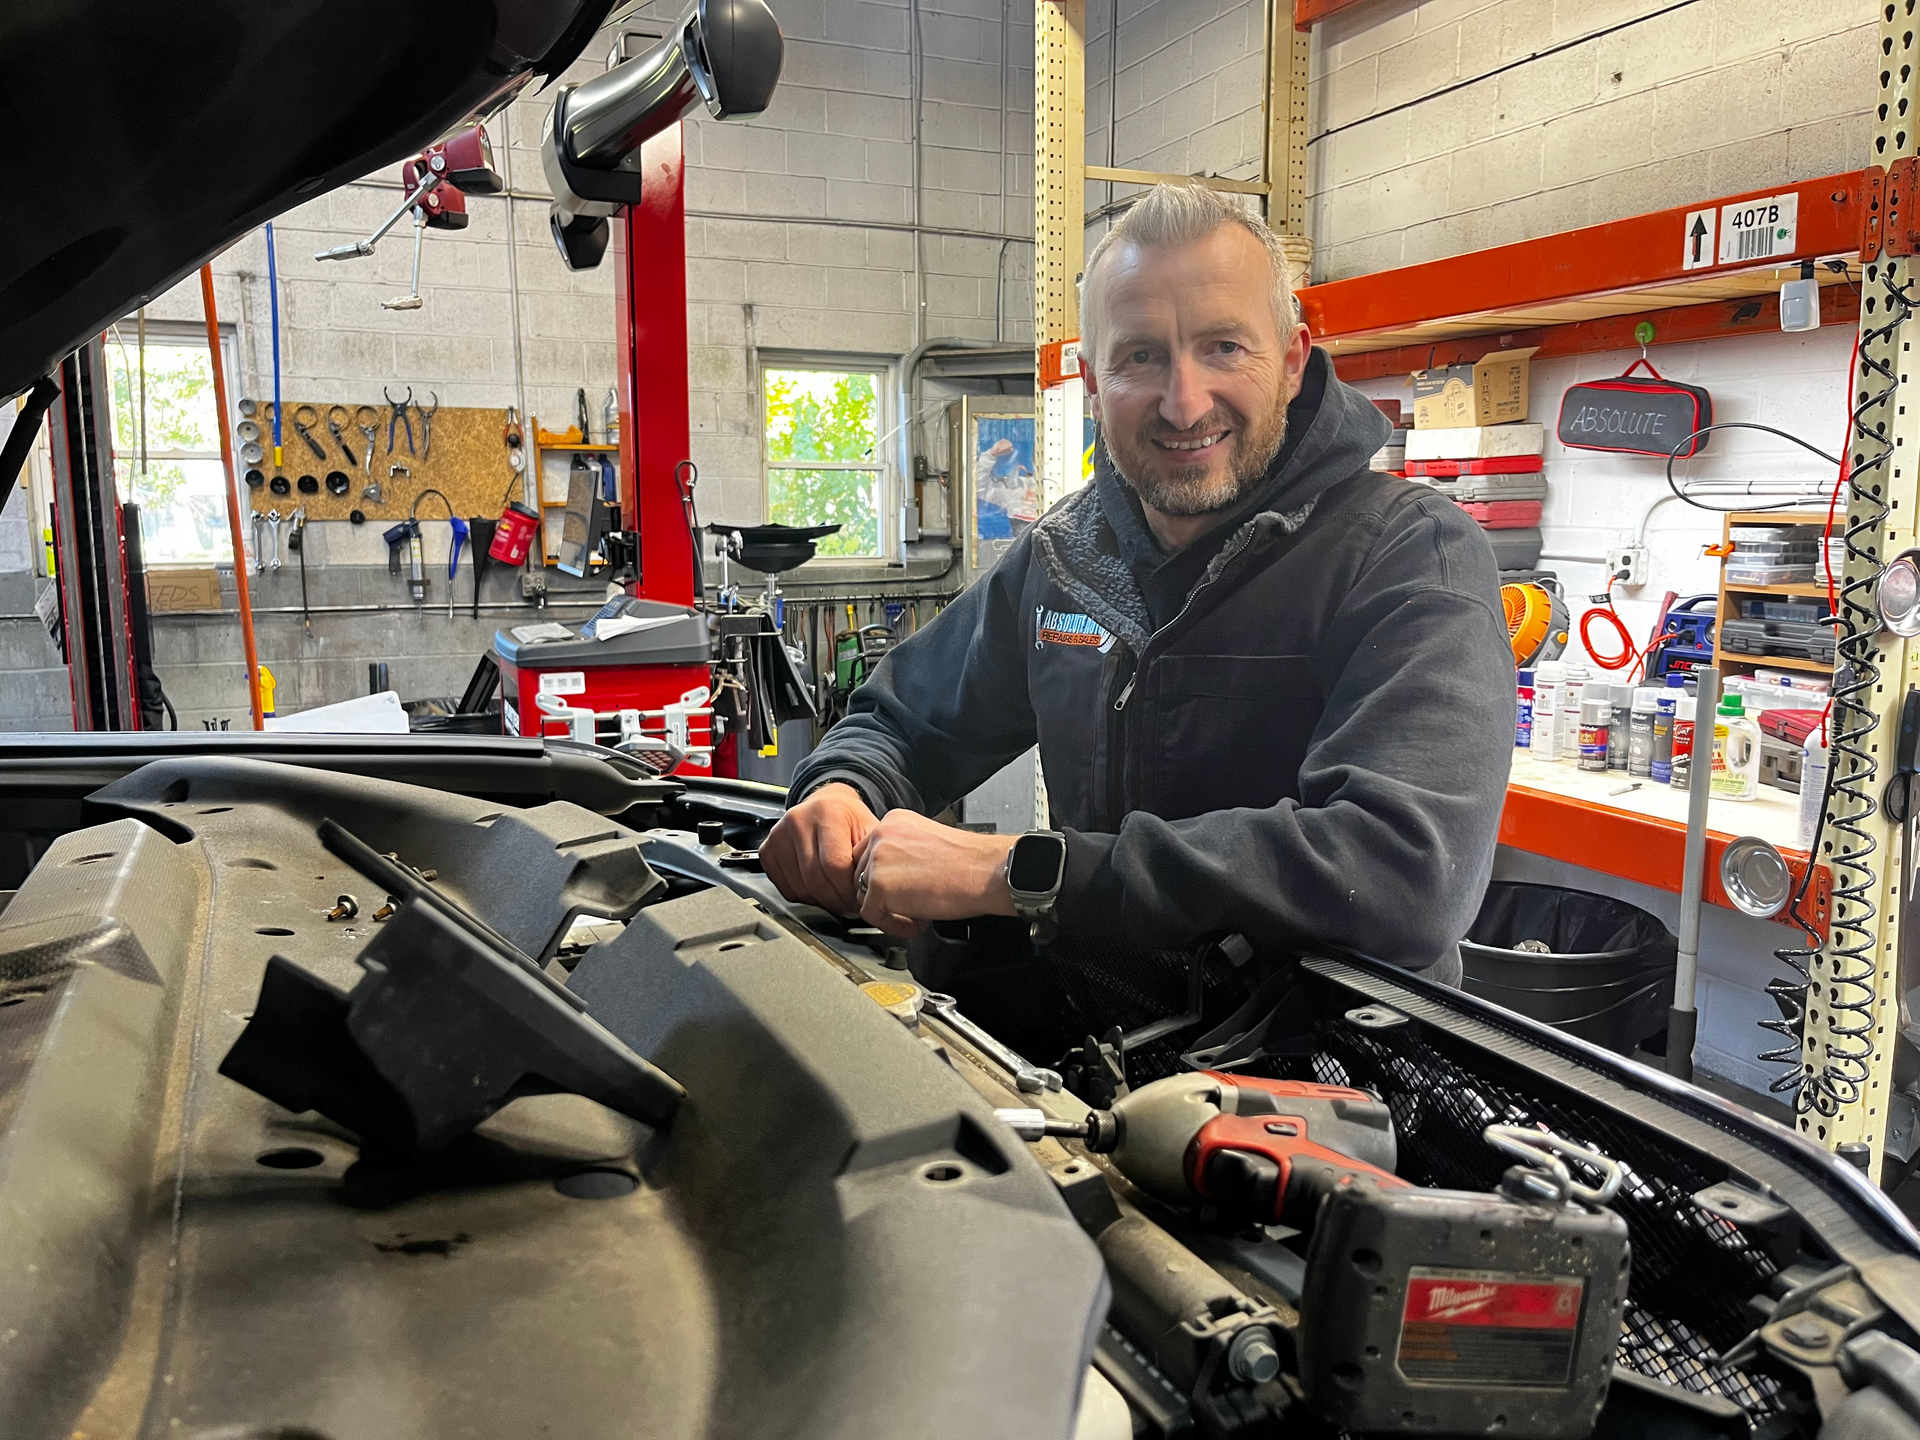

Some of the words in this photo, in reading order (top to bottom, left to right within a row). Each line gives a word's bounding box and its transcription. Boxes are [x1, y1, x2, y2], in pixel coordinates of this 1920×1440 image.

[1732, 204, 1779, 229] 407B
[1570, 405, 1666, 435] ABSOLUTE
[1042, 631, 1073, 643] REPAIRS
[1079, 635, 1100, 645] SALES
[1428, 1284, 1498, 1312] Milwaukee
